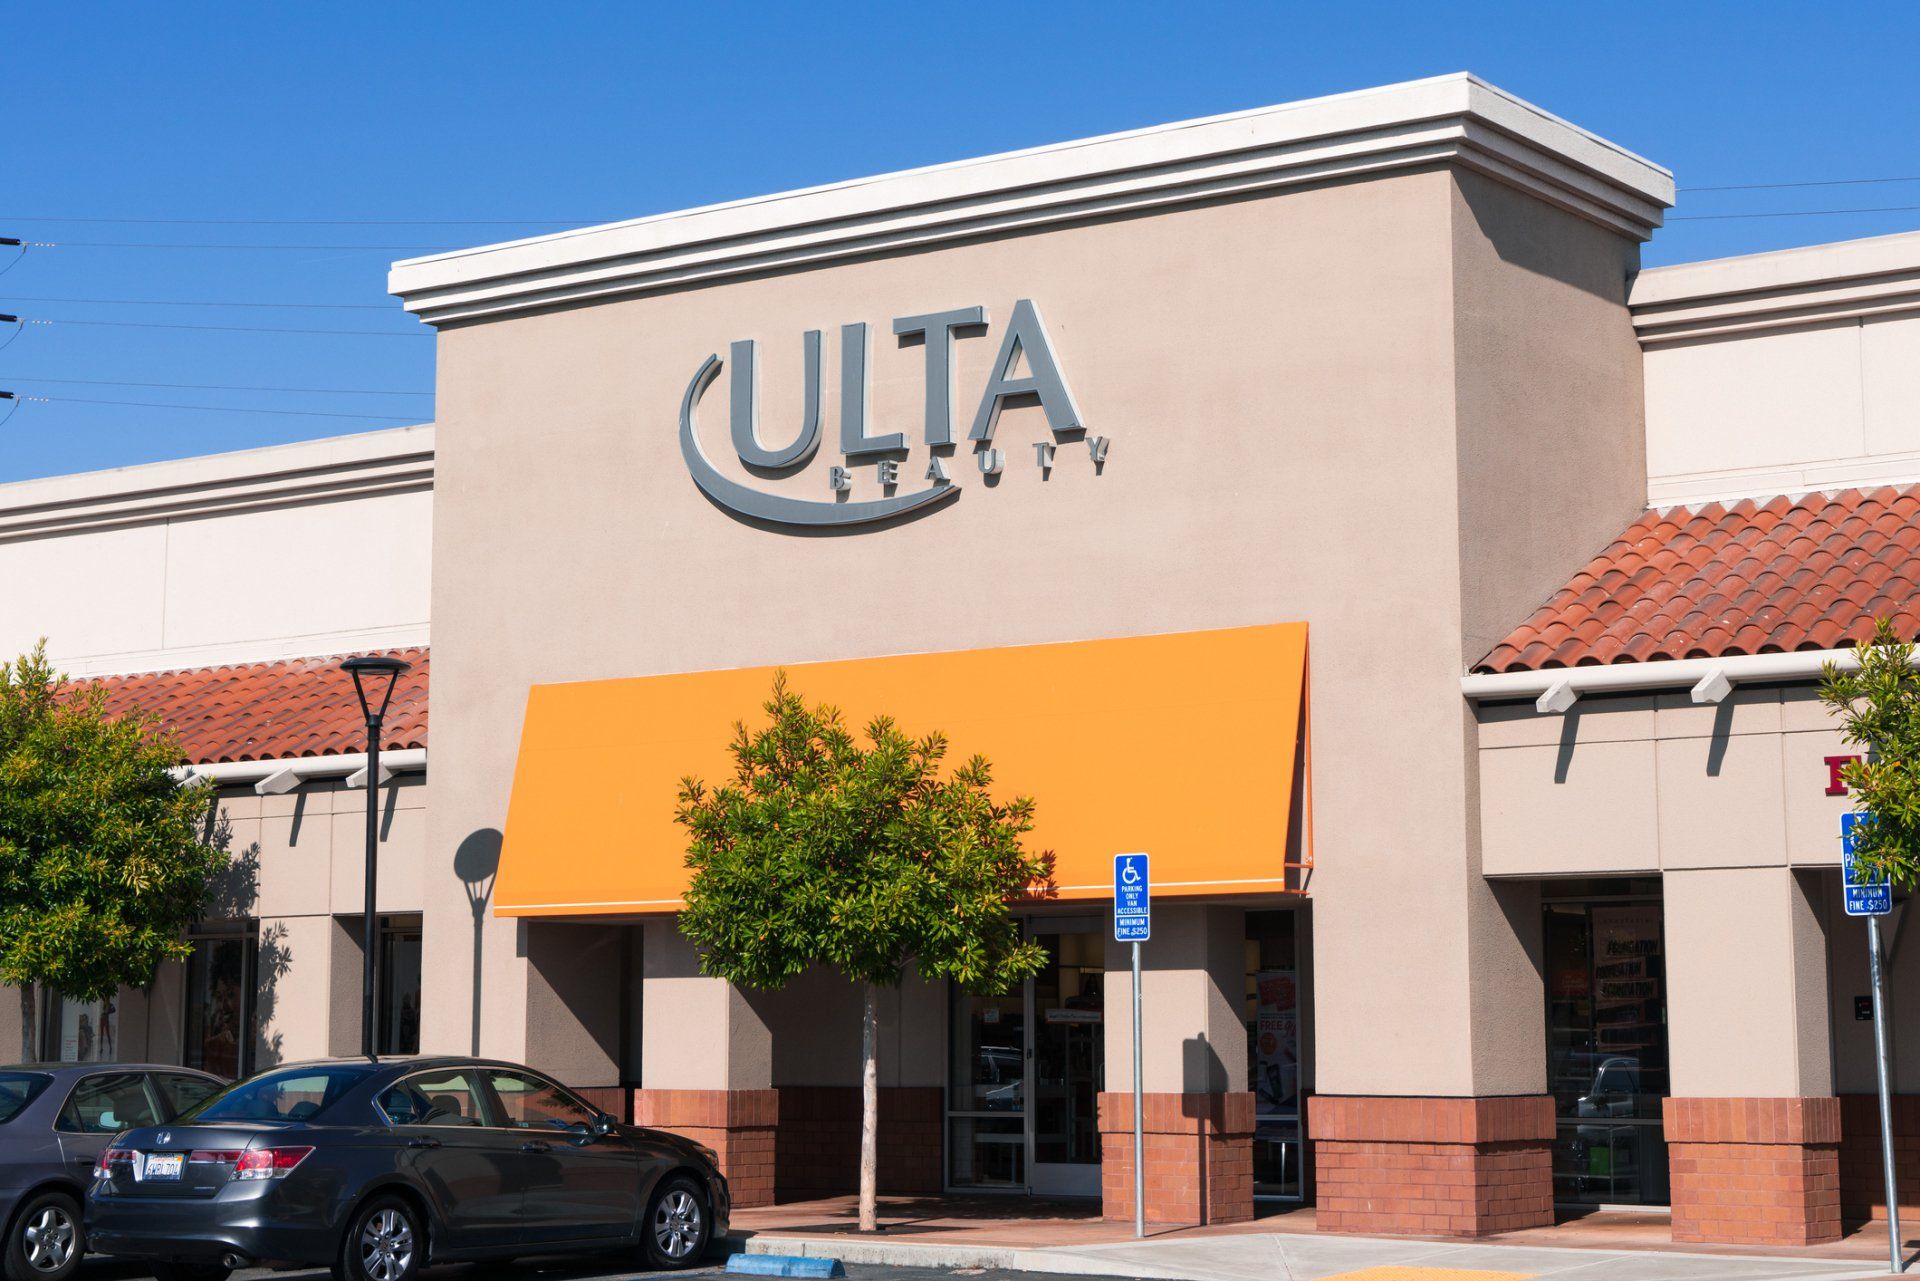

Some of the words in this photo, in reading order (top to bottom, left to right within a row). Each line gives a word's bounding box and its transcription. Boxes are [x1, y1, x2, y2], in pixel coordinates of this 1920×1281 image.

[730, 299, 1086, 468] ULTA
[829, 436, 1110, 491] BEAUTY
[1121, 885, 1143, 893] PARKING
[1852, 888, 1883, 898] MINIMUM
[1125, 892, 1139, 900] ONLY
[1849, 900, 1865, 910] FINE
[1117, 907, 1147, 915] ACCESSIBLE
[1119, 918, 1145, 926] MINIMUM
[1117, 927, 1130, 936] FINE
[1260, 1020, 1283, 1031] FREE
